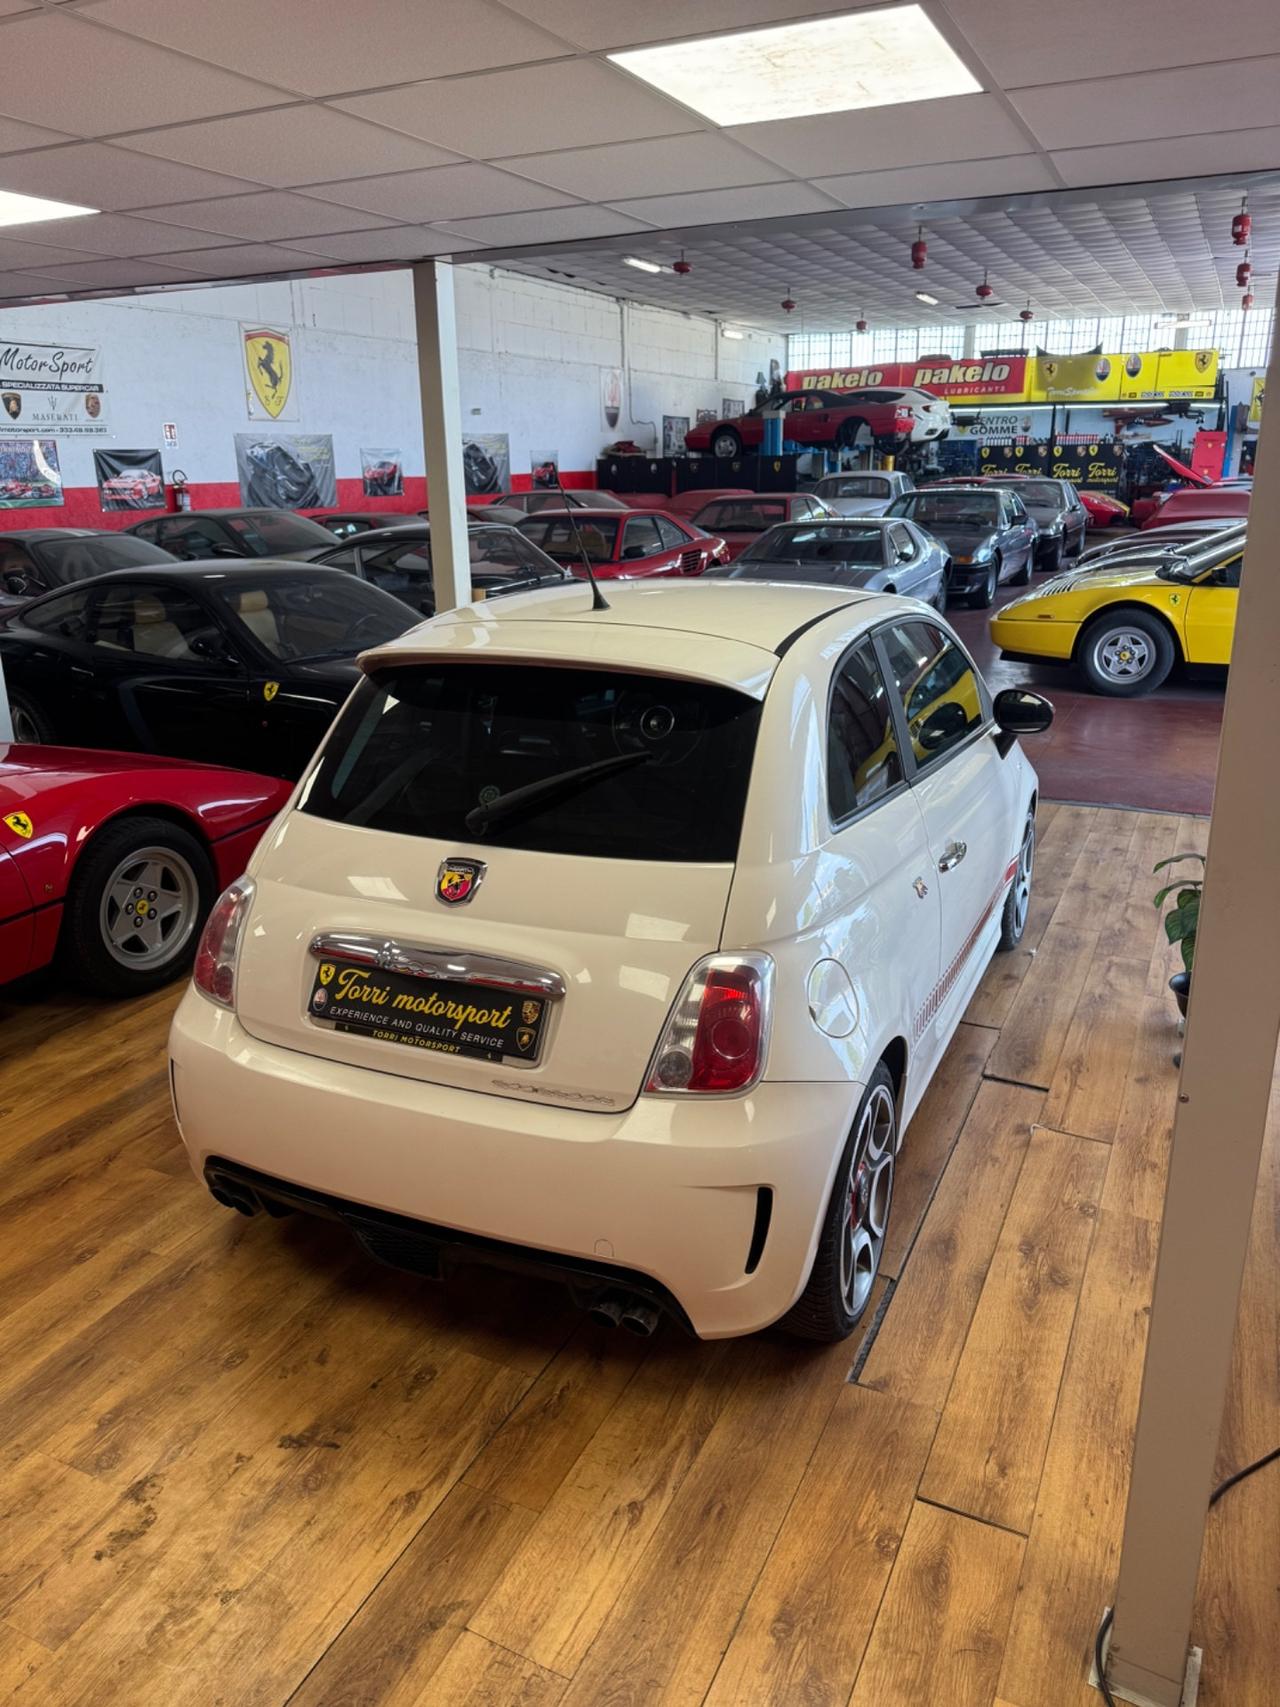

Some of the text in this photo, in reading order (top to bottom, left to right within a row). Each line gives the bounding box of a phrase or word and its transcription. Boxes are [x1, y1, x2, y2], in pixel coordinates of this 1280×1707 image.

[802, 369, 884, 390] pakelo
[913, 361, 1010, 387] pakelo
[944, 386, 1006, 395] LUBRICANTS
[970, 425, 1018, 435] GOMME
[1053, 462, 1081, 478] Torri
[1087, 461, 1117, 478] Torri
[335, 968, 512, 1030] Torri motorsport
[329, 1006, 504, 1048] EXPERIENCE AND QUALITY SERVICE
[372, 1029, 461, 1053] TORRI MOTORSPORT
